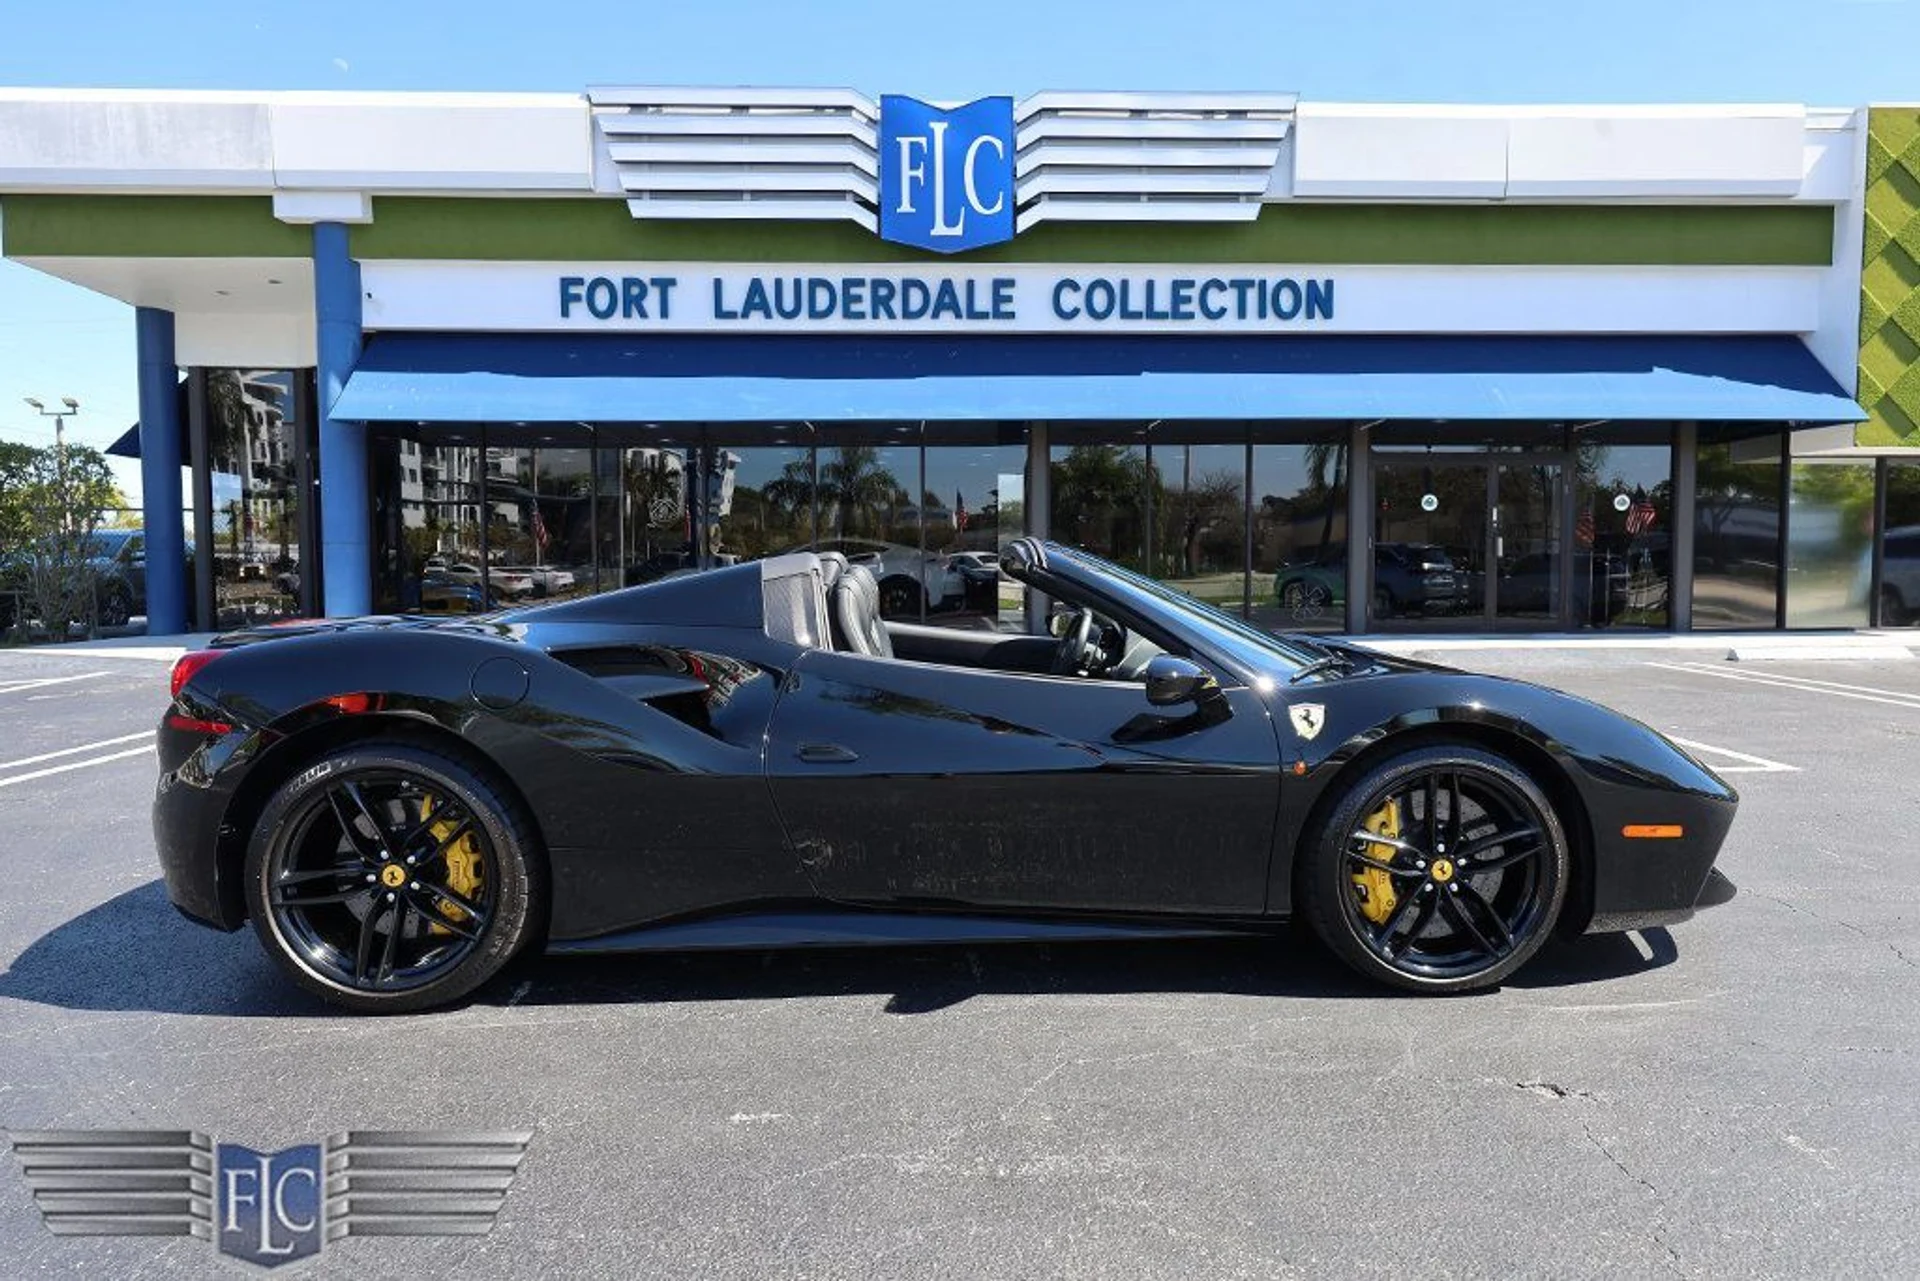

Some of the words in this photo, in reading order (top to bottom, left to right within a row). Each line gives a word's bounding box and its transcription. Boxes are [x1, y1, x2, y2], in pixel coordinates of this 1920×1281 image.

[896, 121, 1003, 237] FLC
[560, 277, 677, 320] FORT
[713, 277, 1016, 320] LAUDERDALE
[1051, 277, 1335, 321] COLLECTION
